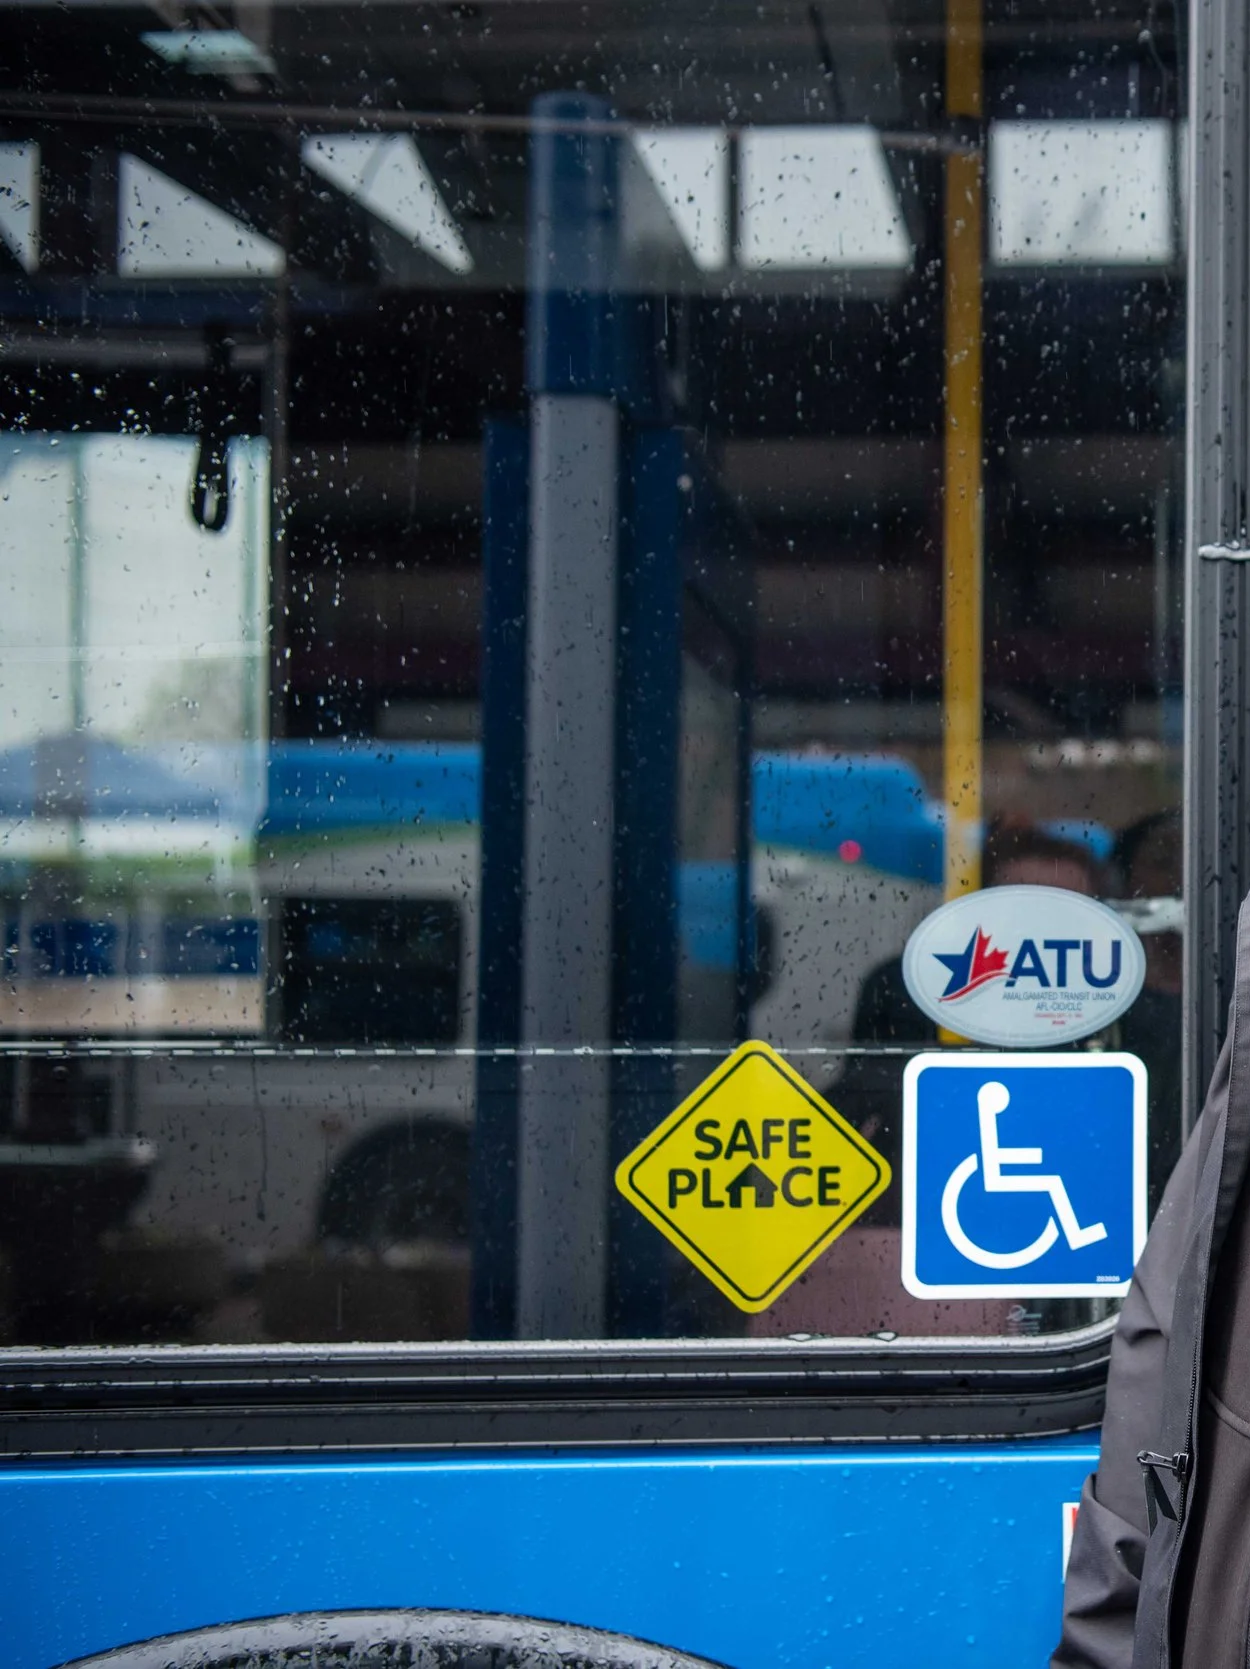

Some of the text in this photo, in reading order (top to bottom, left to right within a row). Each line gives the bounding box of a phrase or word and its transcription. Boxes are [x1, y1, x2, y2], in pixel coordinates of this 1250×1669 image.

[1004, 938, 1122, 988] ATU
[1002, 991, 1116, 1001] AMALGAMATED TRANSIT UNION
[694, 1118, 812, 1161] SAFE
